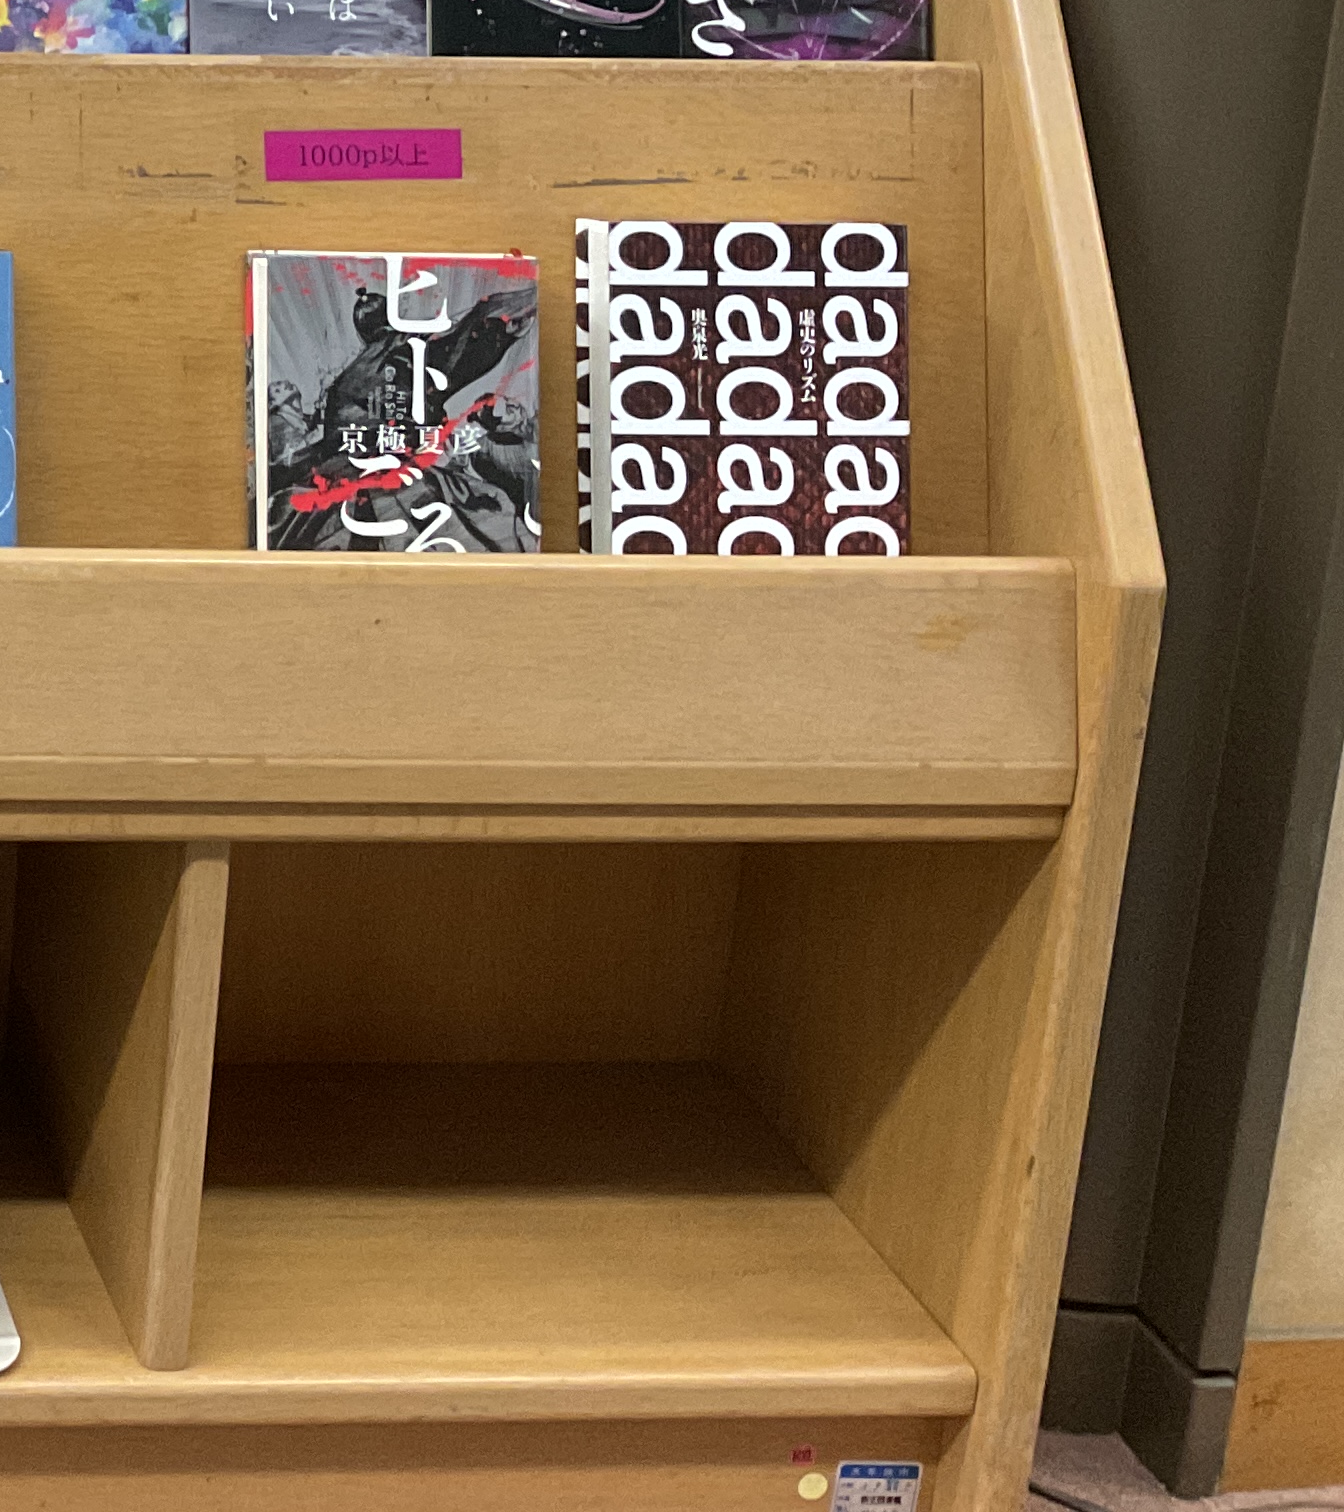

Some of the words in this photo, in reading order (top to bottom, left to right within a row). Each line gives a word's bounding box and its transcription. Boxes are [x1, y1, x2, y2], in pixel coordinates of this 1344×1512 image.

[297, 142, 430, 169] 1000p以上
[384, 255, 453, 425] ヒト
[690, 307, 709, 361] 奥泉光
[337, 423, 483, 457] 京極夏彦
